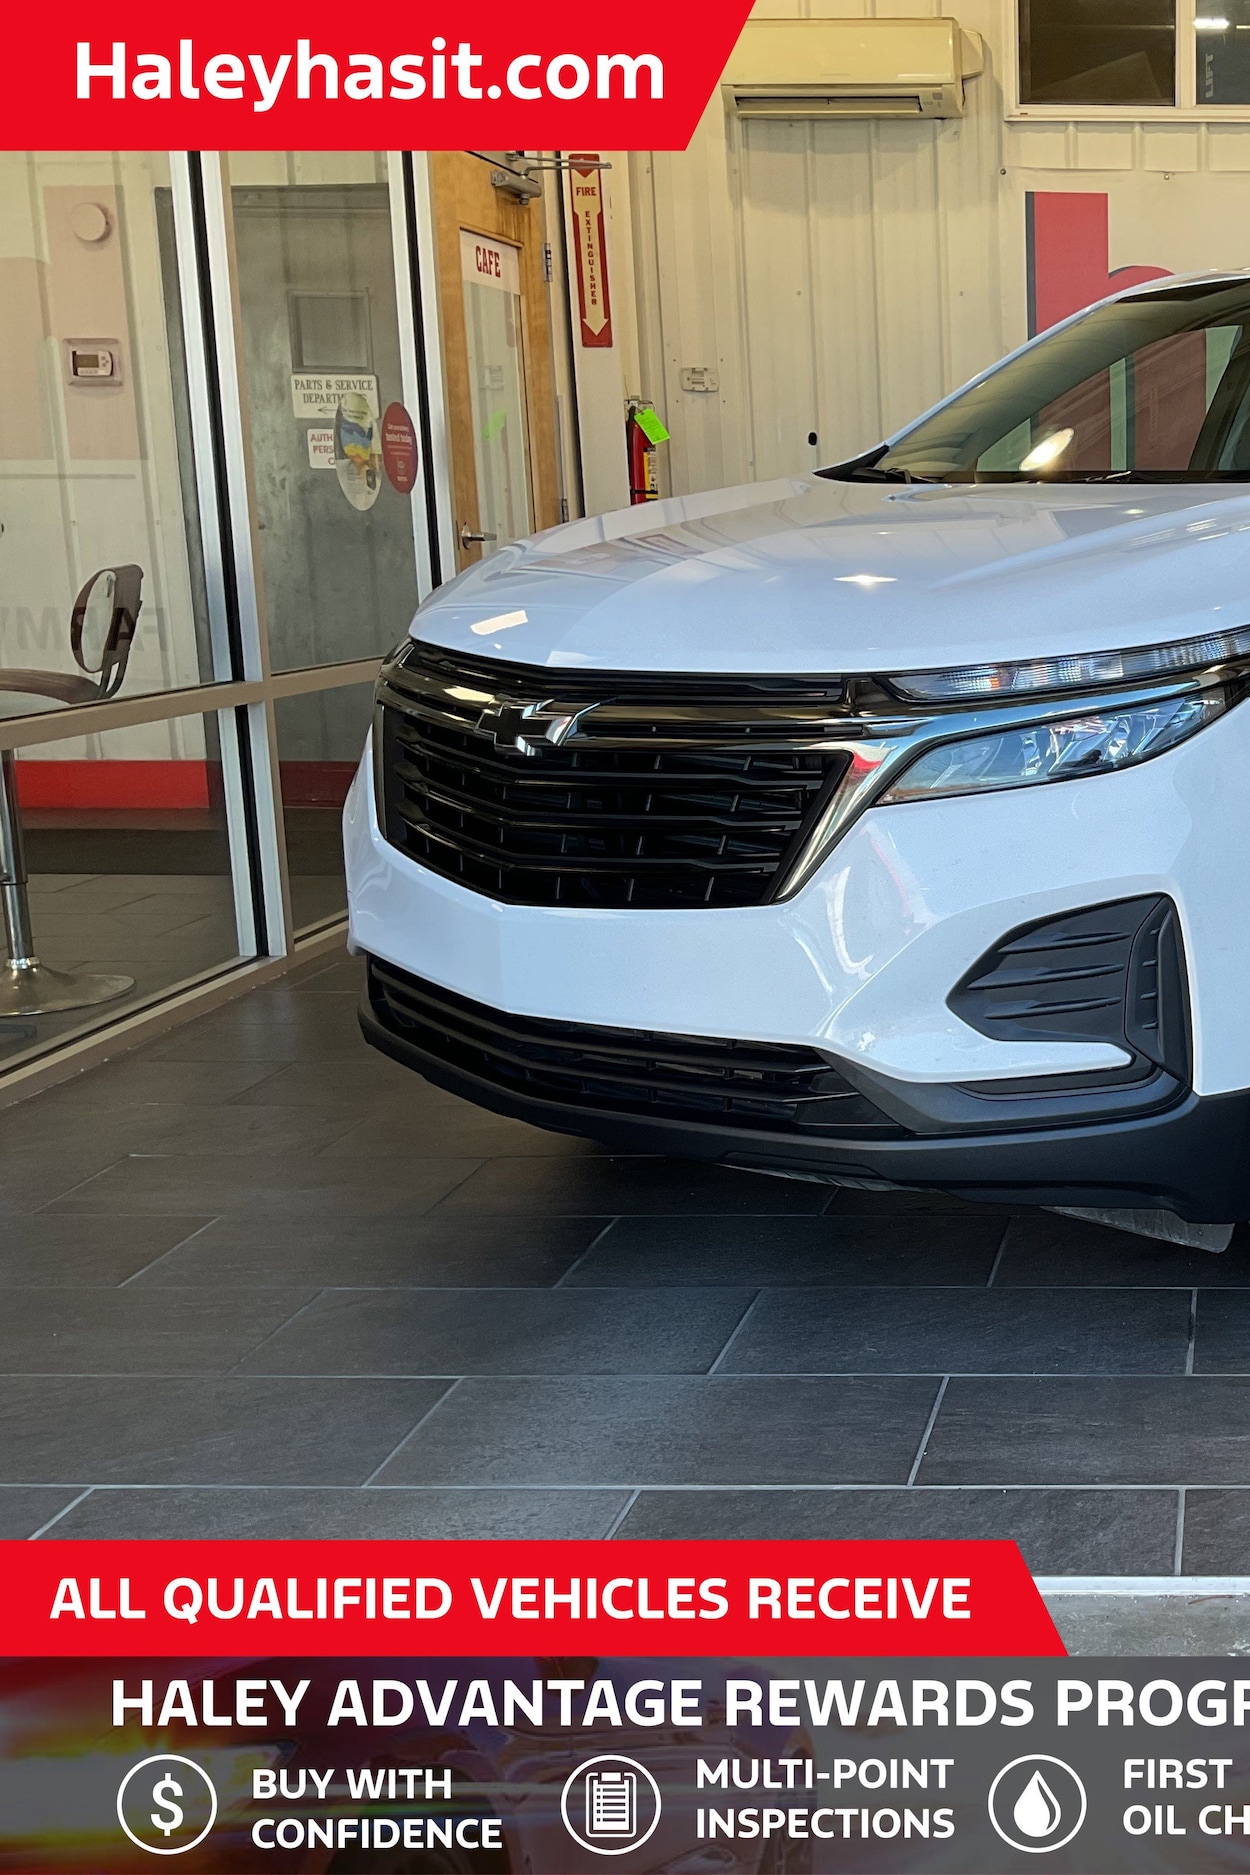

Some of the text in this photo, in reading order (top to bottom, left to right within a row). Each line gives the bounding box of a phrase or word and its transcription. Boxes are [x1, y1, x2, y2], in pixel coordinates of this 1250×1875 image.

[576, 186, 597, 197] FIRE
[475, 245, 501, 279] CAFE
[585, 210, 598, 305] EXTINGUISHER
[294, 379, 374, 391] PARTS & SERVICE
[310, 433, 334, 442] AUTH
[313, 445, 334, 454] PERS
